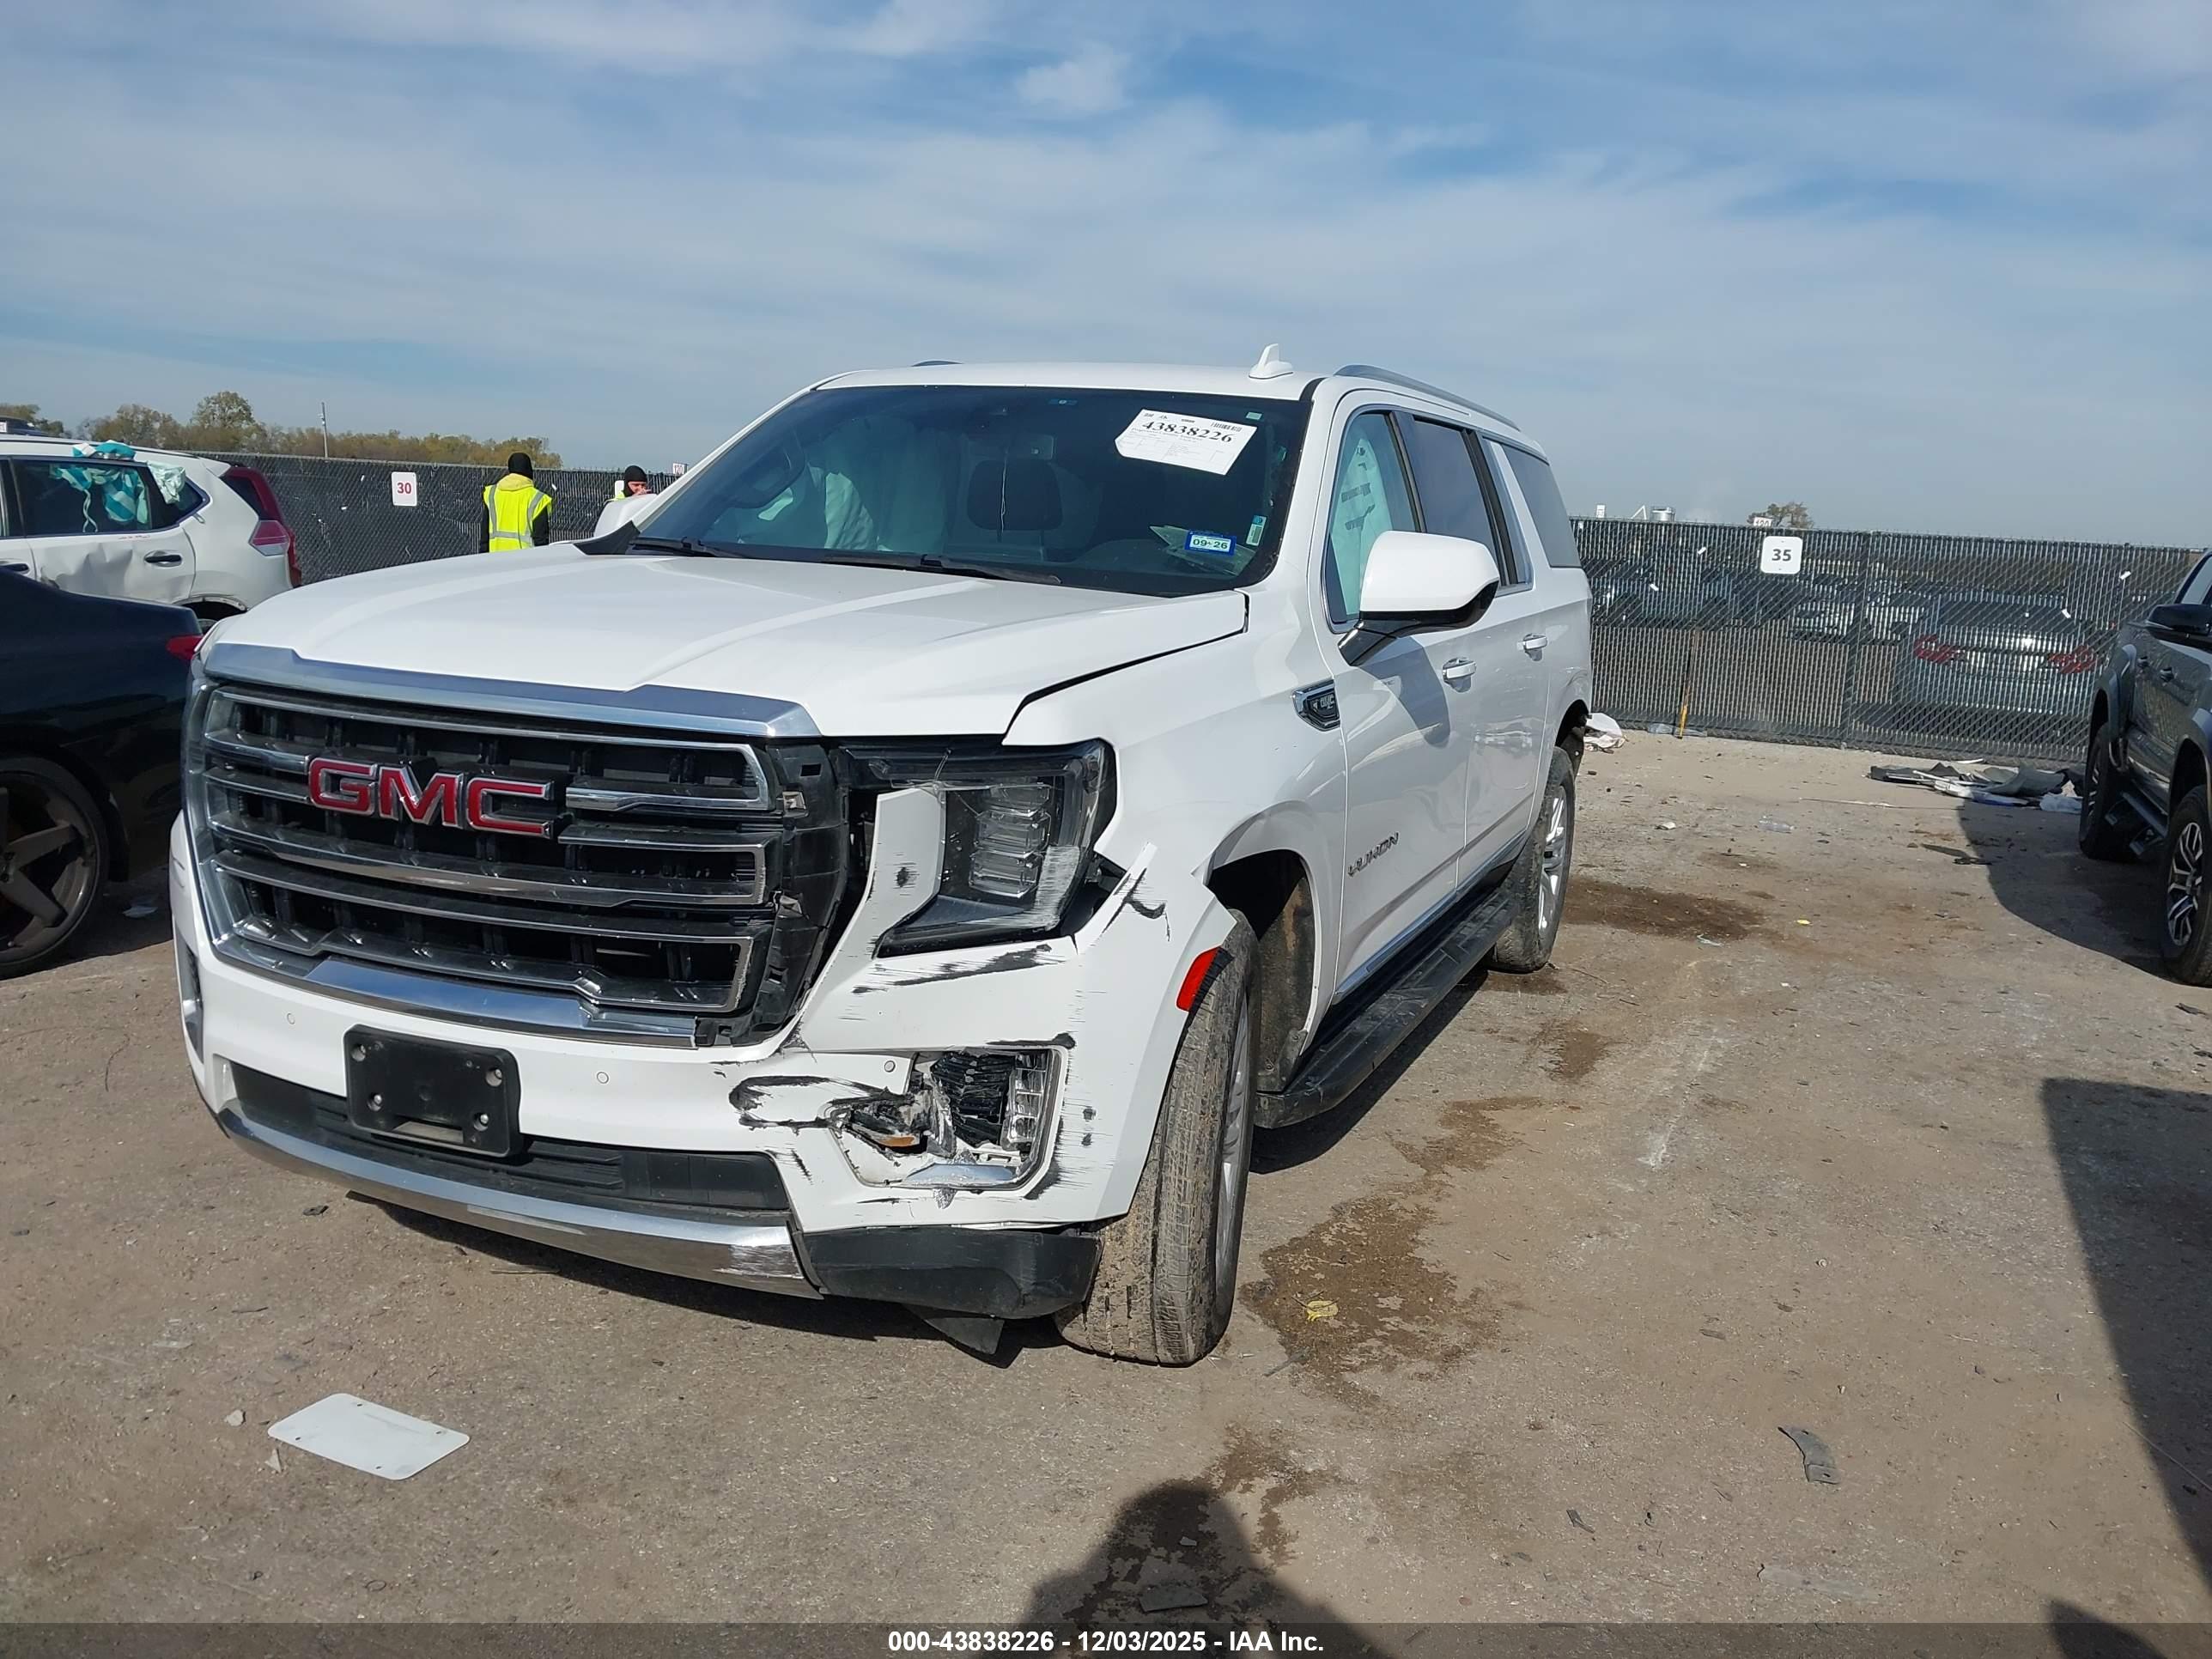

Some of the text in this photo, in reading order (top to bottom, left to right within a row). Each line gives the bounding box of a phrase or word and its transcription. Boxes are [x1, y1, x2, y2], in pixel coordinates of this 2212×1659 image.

[1142, 421, 1235, 443] 43838226
[397, 482, 412, 495] 30
[1771, 548, 1792, 562] 35
[308, 757, 555, 839] GMC
[1347, 831, 1400, 877] YUKON
